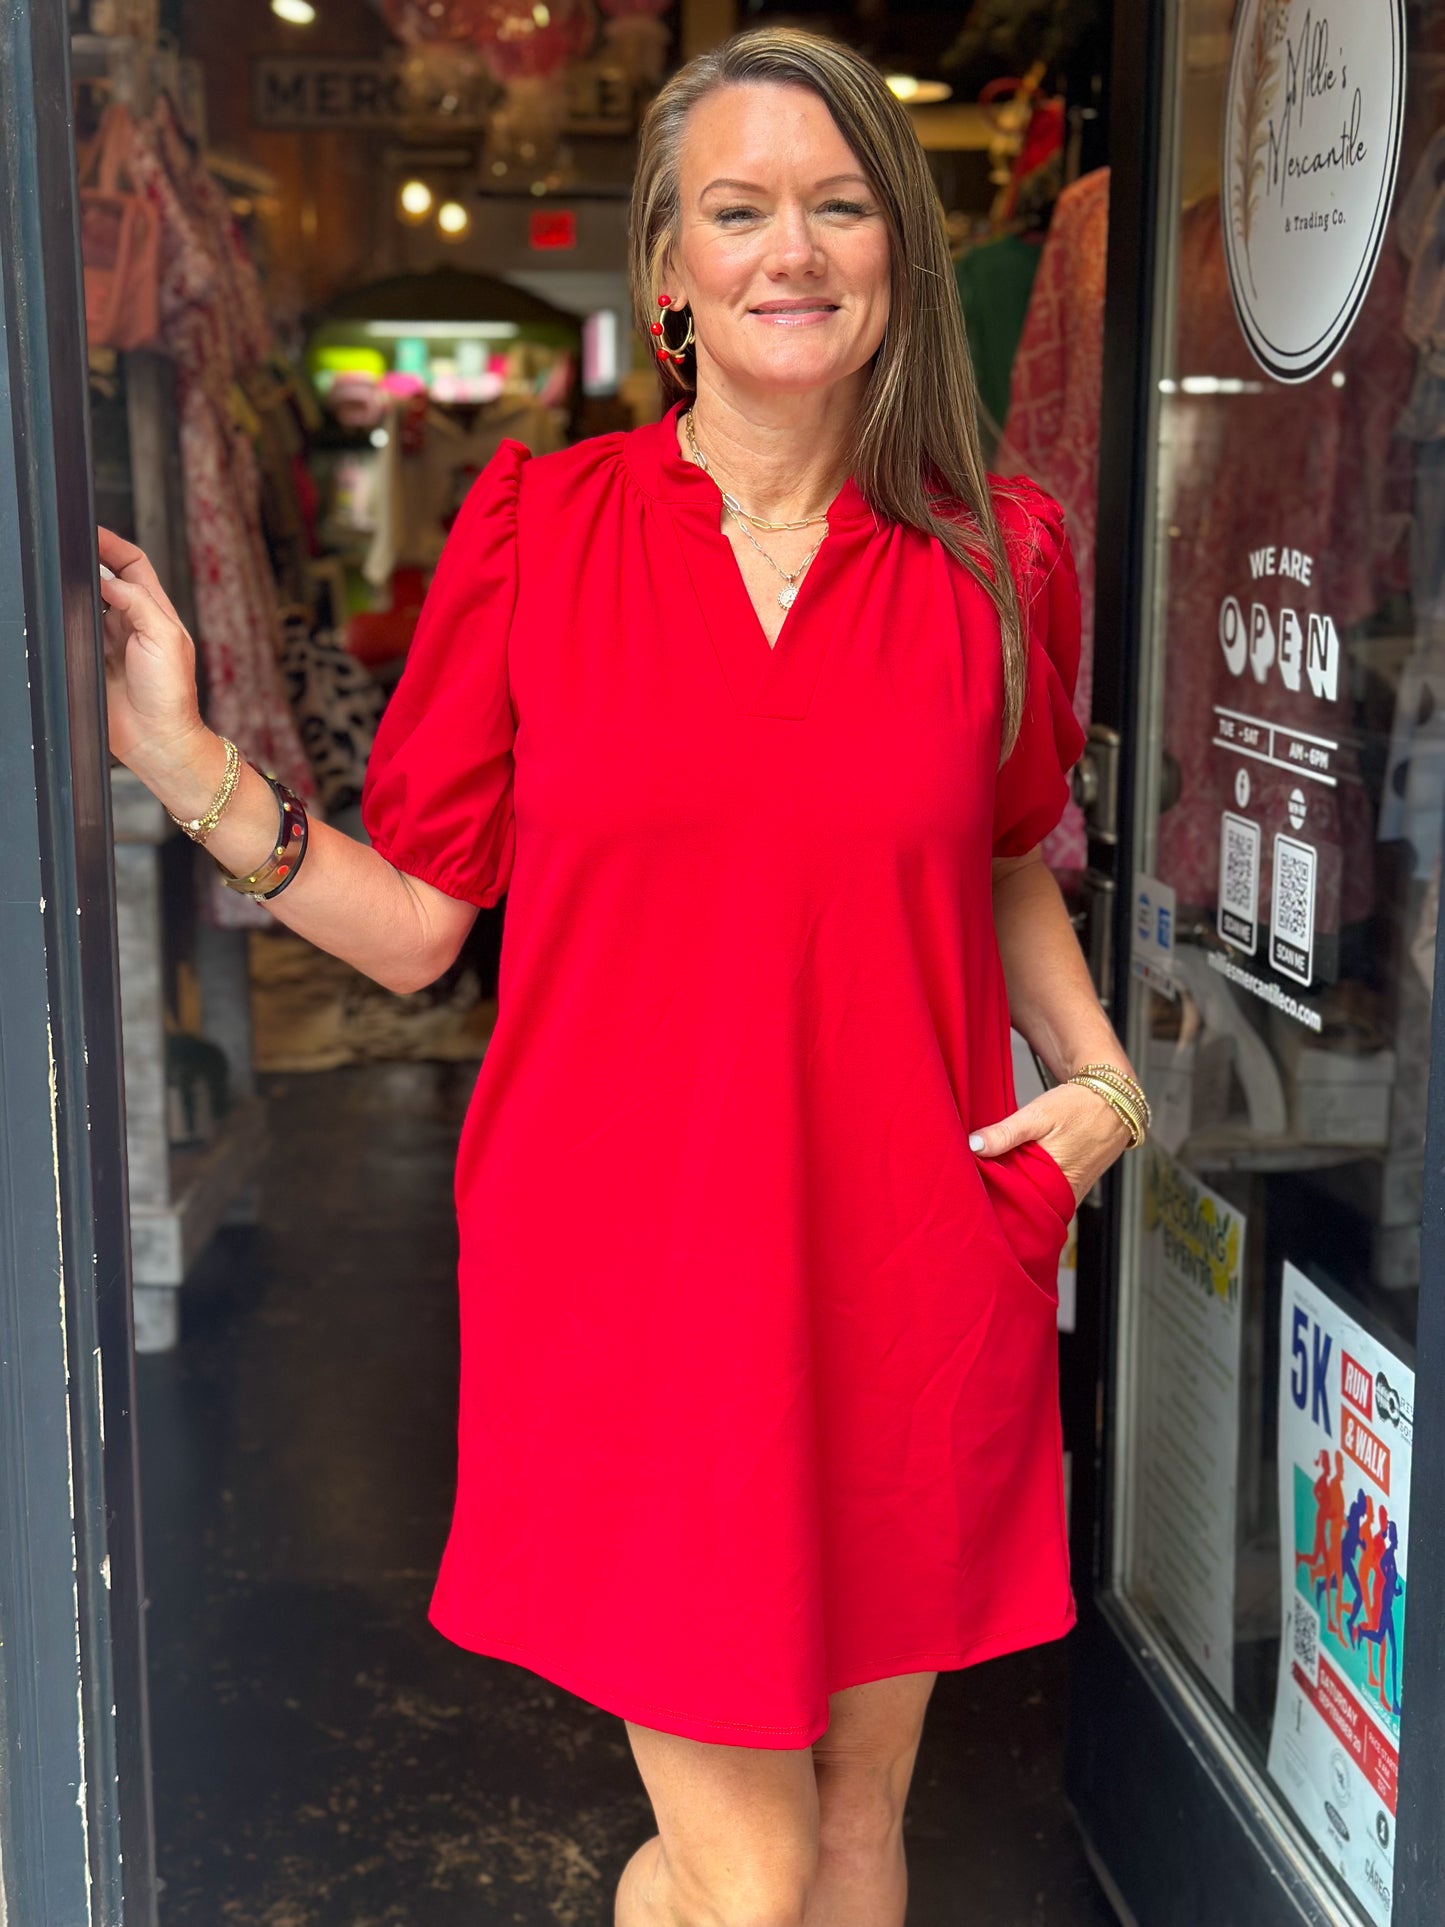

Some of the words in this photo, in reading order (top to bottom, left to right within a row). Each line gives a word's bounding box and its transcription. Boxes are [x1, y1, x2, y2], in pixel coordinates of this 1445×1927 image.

[1286, 8, 1347, 128] Millie's
[1267, 87, 1367, 208] Mercantile
[1285, 217, 1291, 233] &
[1294, 212, 1329, 232] Trading
[1332, 208, 1346, 225] Co.
[1249, 547, 1276, 579] WE
[1278, 547, 1313, 587] ARE
[1219, 596, 1339, 702] OPEN
[1276, 943, 1293, 967] SCAN
[1294, 950, 1306, 972] ME
[1290, 1303, 1333, 1438] 5K
[1344, 1361, 1369, 1409] RUN
[1344, 1417, 1353, 1450] &
[1355, 1426, 1387, 1482] WALK
[1319, 1689, 1353, 1743] SEPTEMBER
[1320, 1669, 1358, 1727] SATURDAY
